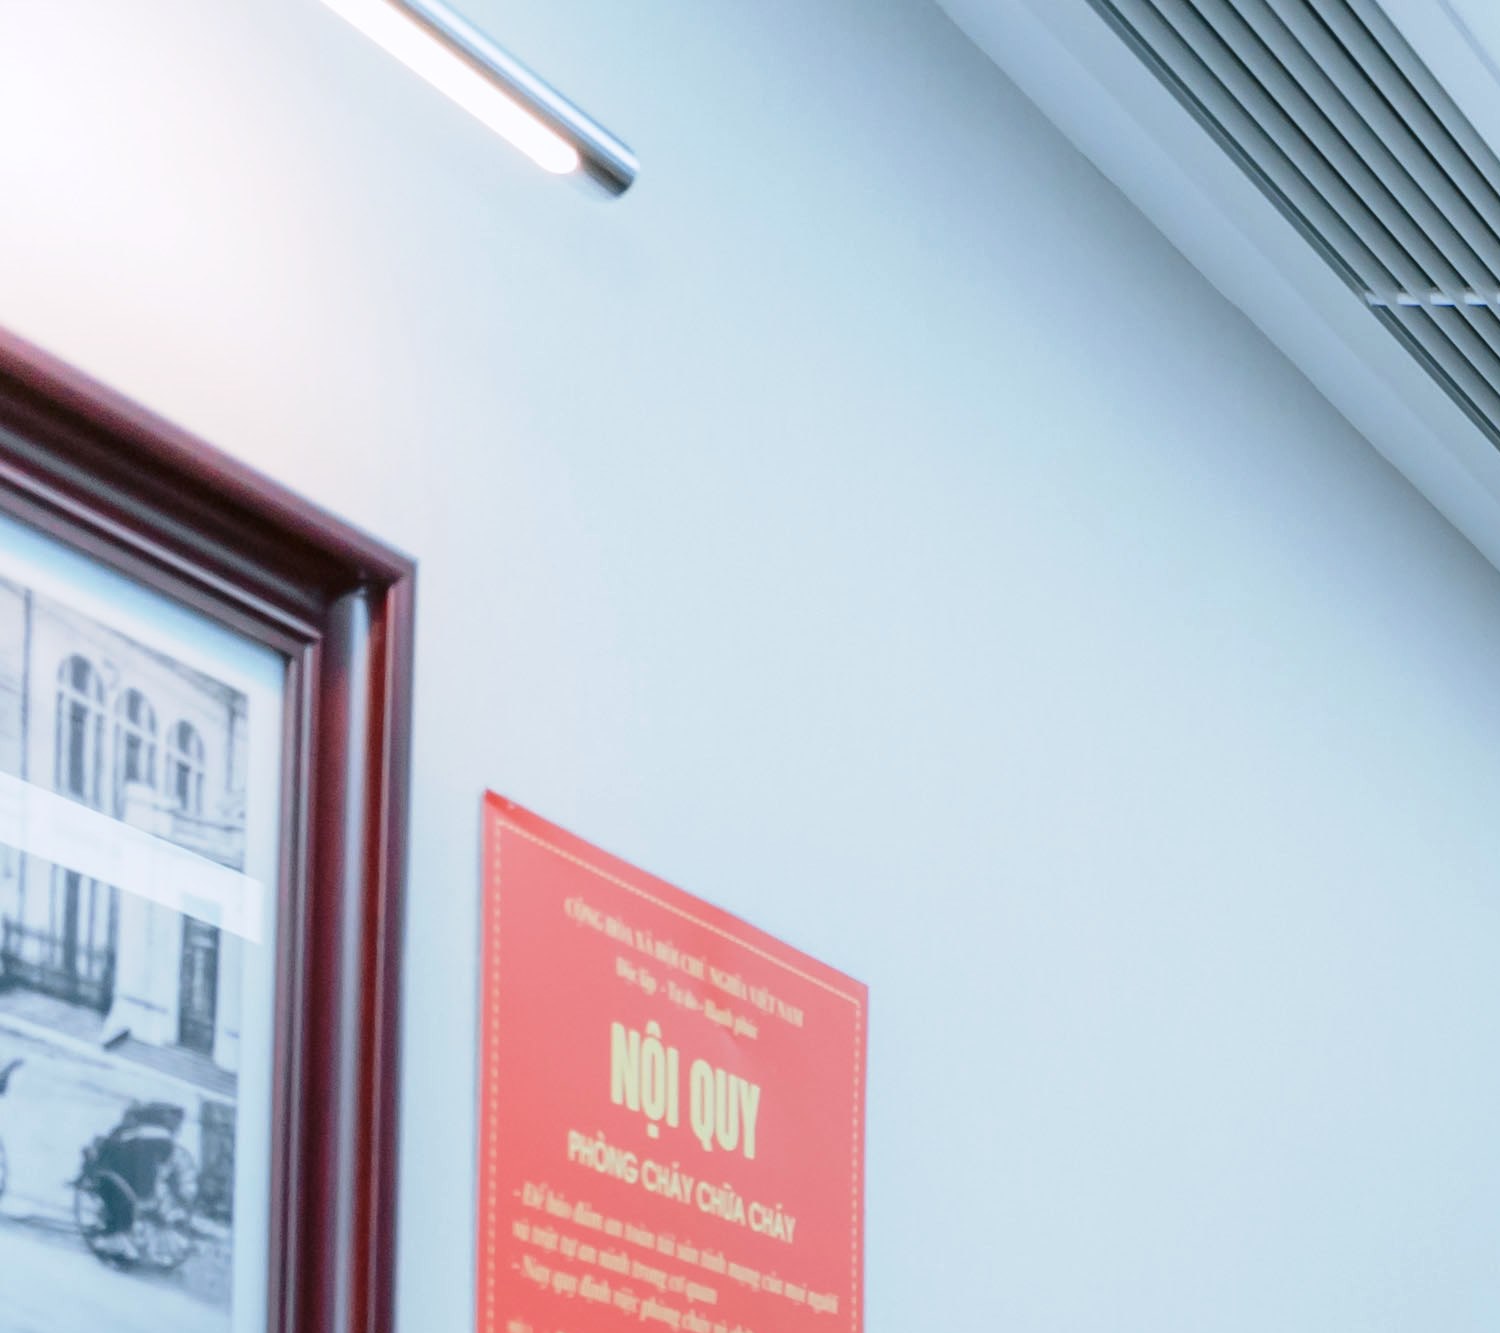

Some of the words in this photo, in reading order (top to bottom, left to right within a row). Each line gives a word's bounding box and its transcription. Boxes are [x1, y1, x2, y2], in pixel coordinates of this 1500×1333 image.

[610, 1019, 679, 1140] NỘI
[689, 1058, 761, 1160] QUY
[567, 1129, 638, 1184] PHÒNG
[641, 1160, 694, 1204] CHÁY
[696, 1181, 747, 1227] CHỮA
[748, 1201, 796, 1244] CHÁY
